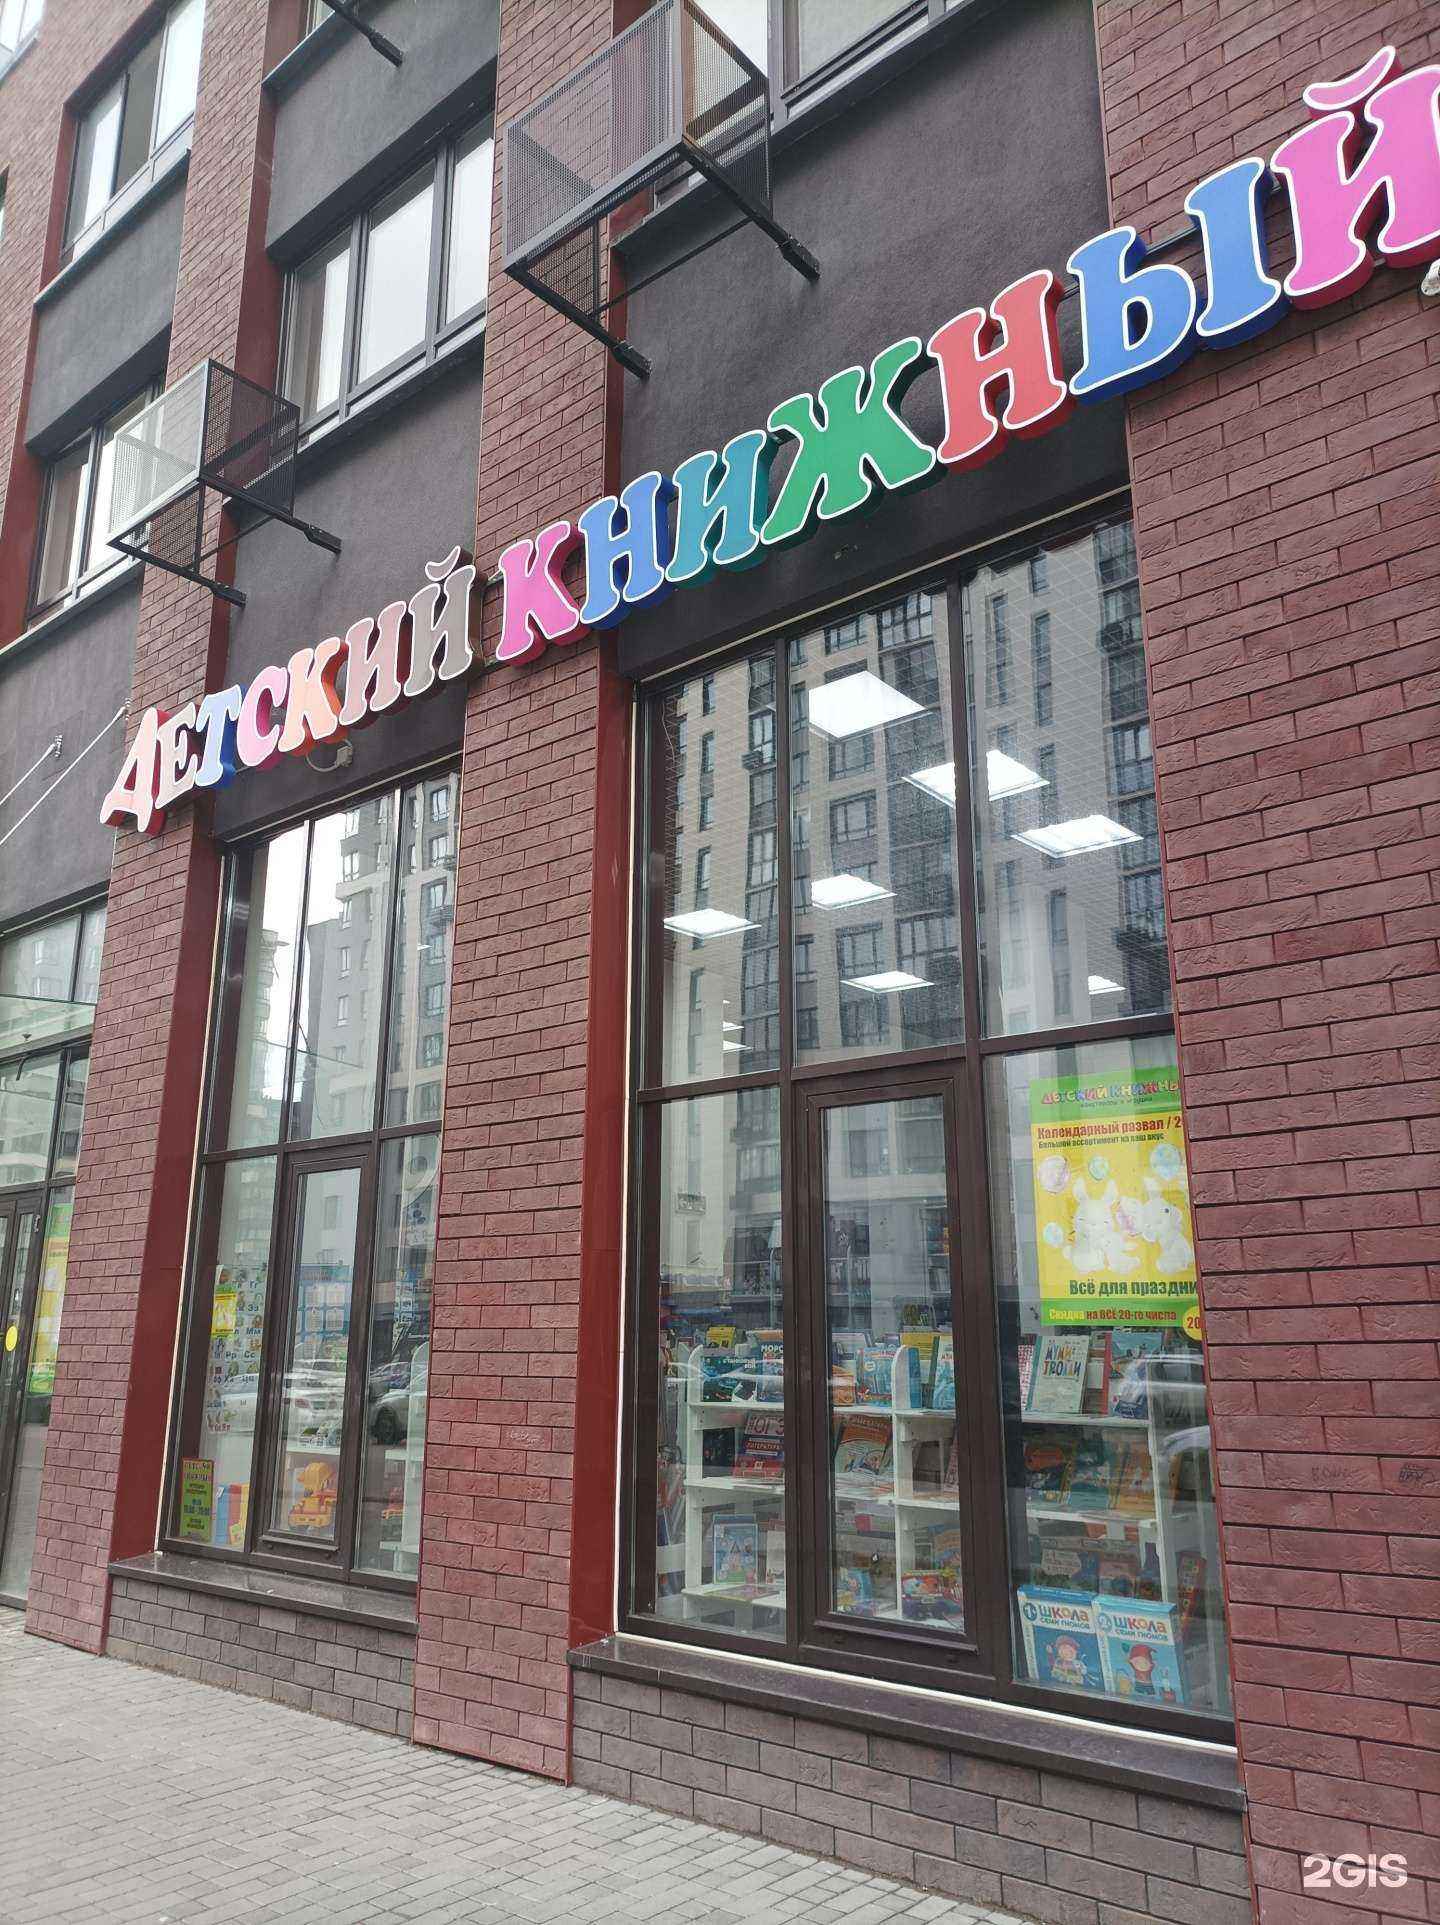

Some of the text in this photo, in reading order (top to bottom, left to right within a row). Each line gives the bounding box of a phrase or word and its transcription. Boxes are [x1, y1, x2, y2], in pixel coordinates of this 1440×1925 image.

[99, 44, 1440, 833] ДЕТСКИЙ КНИЖНЫЙ
[1037, 1120, 1120, 1139] Календарный
[1121, 1119, 1164, 1135] развал
[1069, 1279, 1095, 1295] Всё
[1099, 1281, 1128, 1297] для
